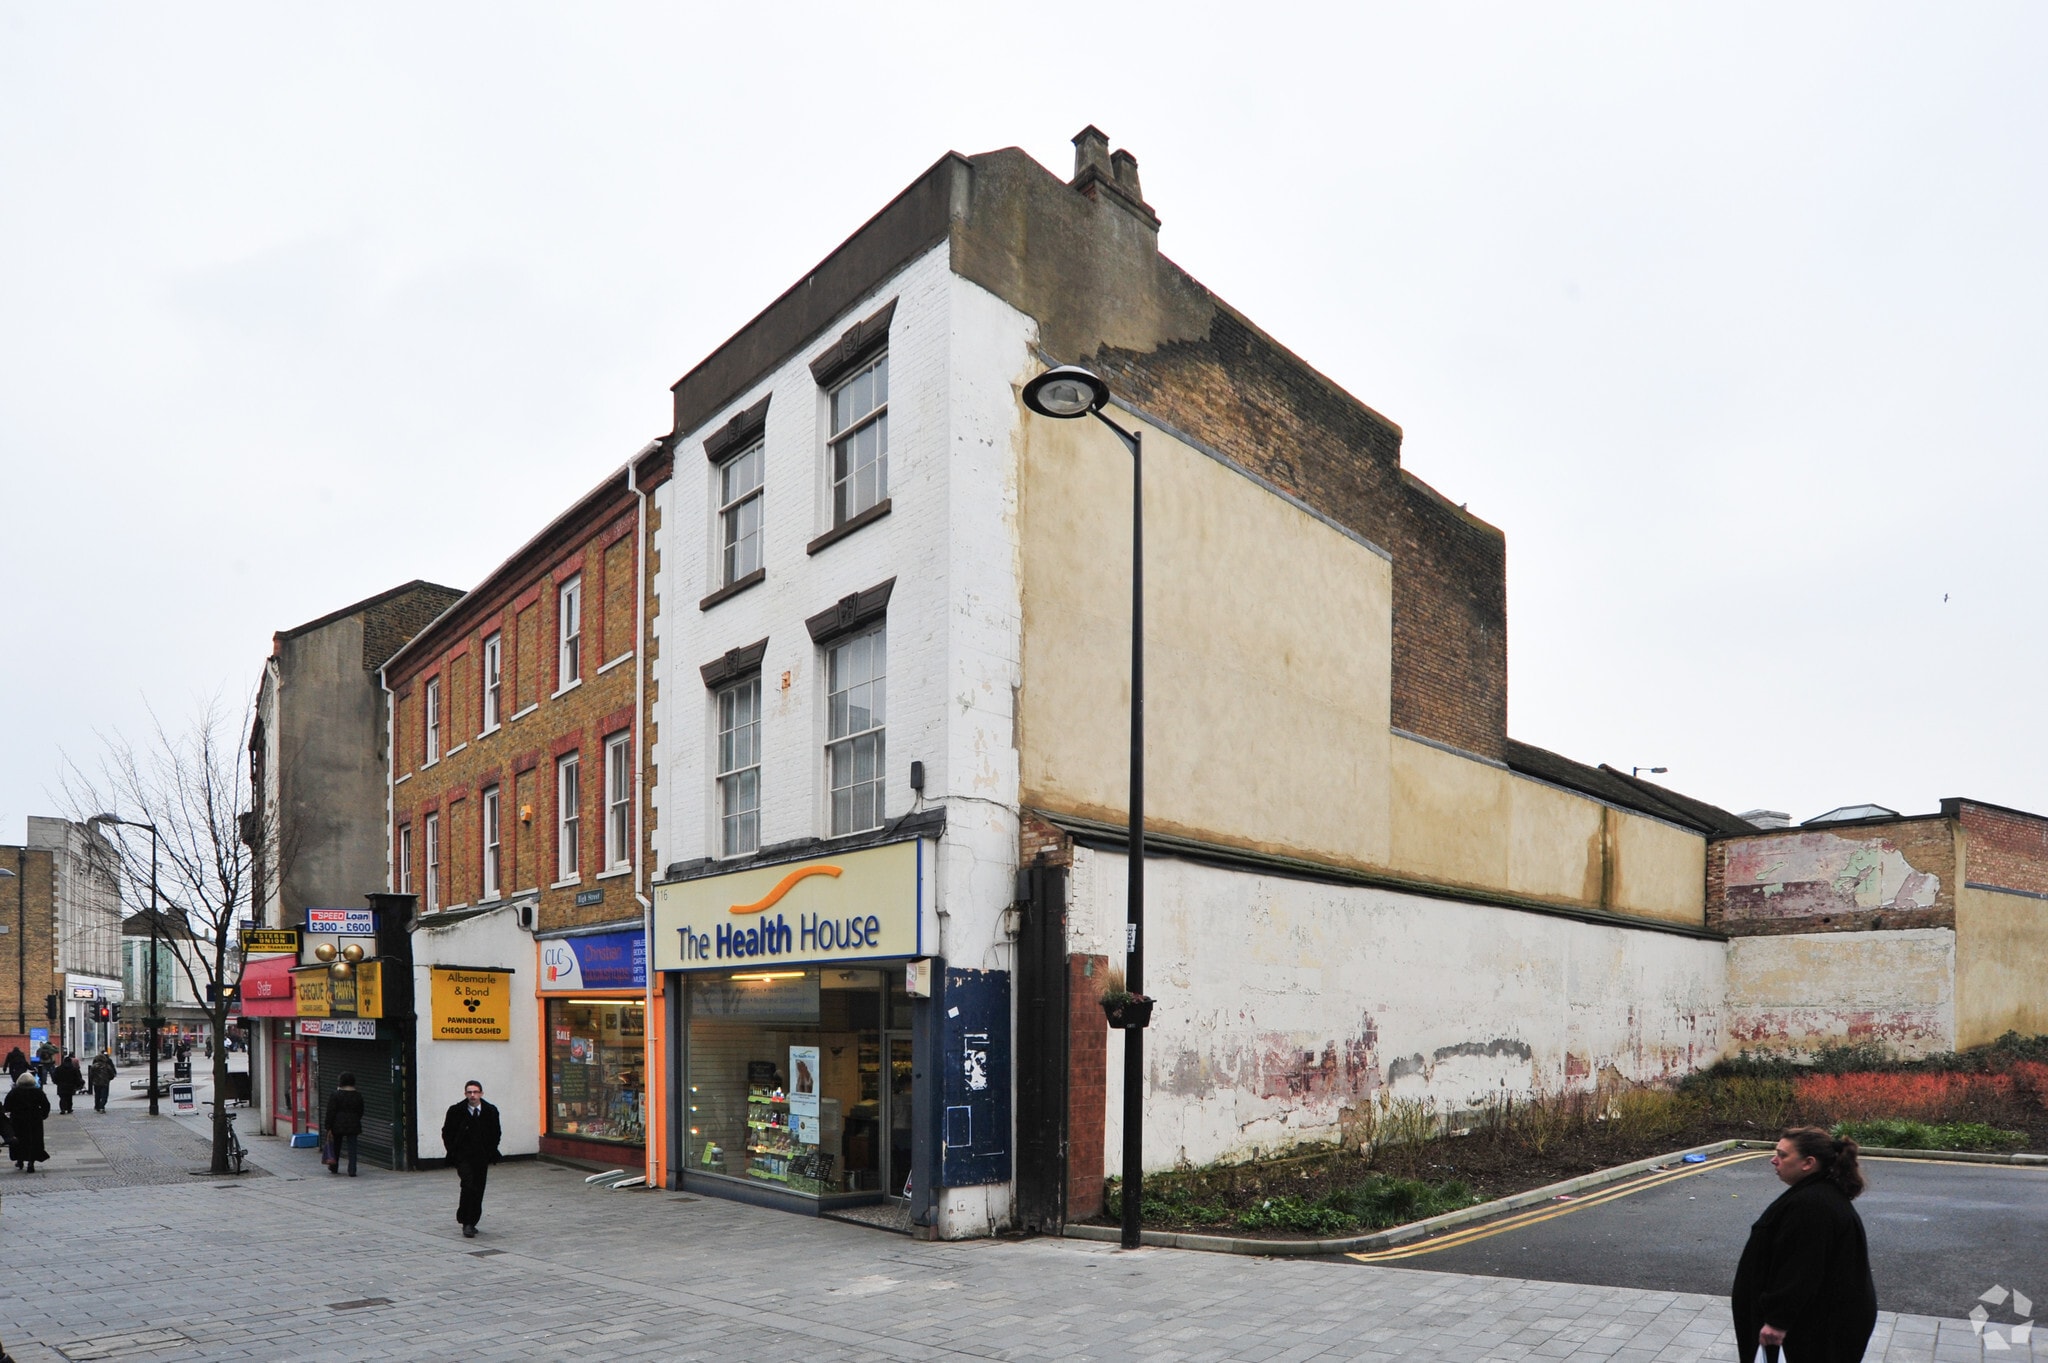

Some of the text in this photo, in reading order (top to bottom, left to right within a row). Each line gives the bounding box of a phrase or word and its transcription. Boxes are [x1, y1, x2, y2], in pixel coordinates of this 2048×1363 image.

[656, 889, 668, 901] 116
[318, 911, 369, 920] SPEED Loan
[312, 922, 337, 931] £300
[346, 923, 371, 932] £600
[676, 912, 880, 960] The Health House
[545, 948, 564, 965] CLC
[584, 944, 622, 962] Christian
[447, 972, 497, 984] Albemarle
[300, 983, 324, 1001] CHEQUE
[454, 986, 490, 997] & Bond
[447, 1016, 496, 1024] PAWNBROKER
[304, 1021, 320, 1032] SPEED
[320, 1021, 336, 1033] Loan
[336, 1020, 353, 1035] £300
[357, 1021, 375, 1037] £600
[475, 1027, 502, 1035] CASHED
[556, 1030, 570, 1041] SALE
